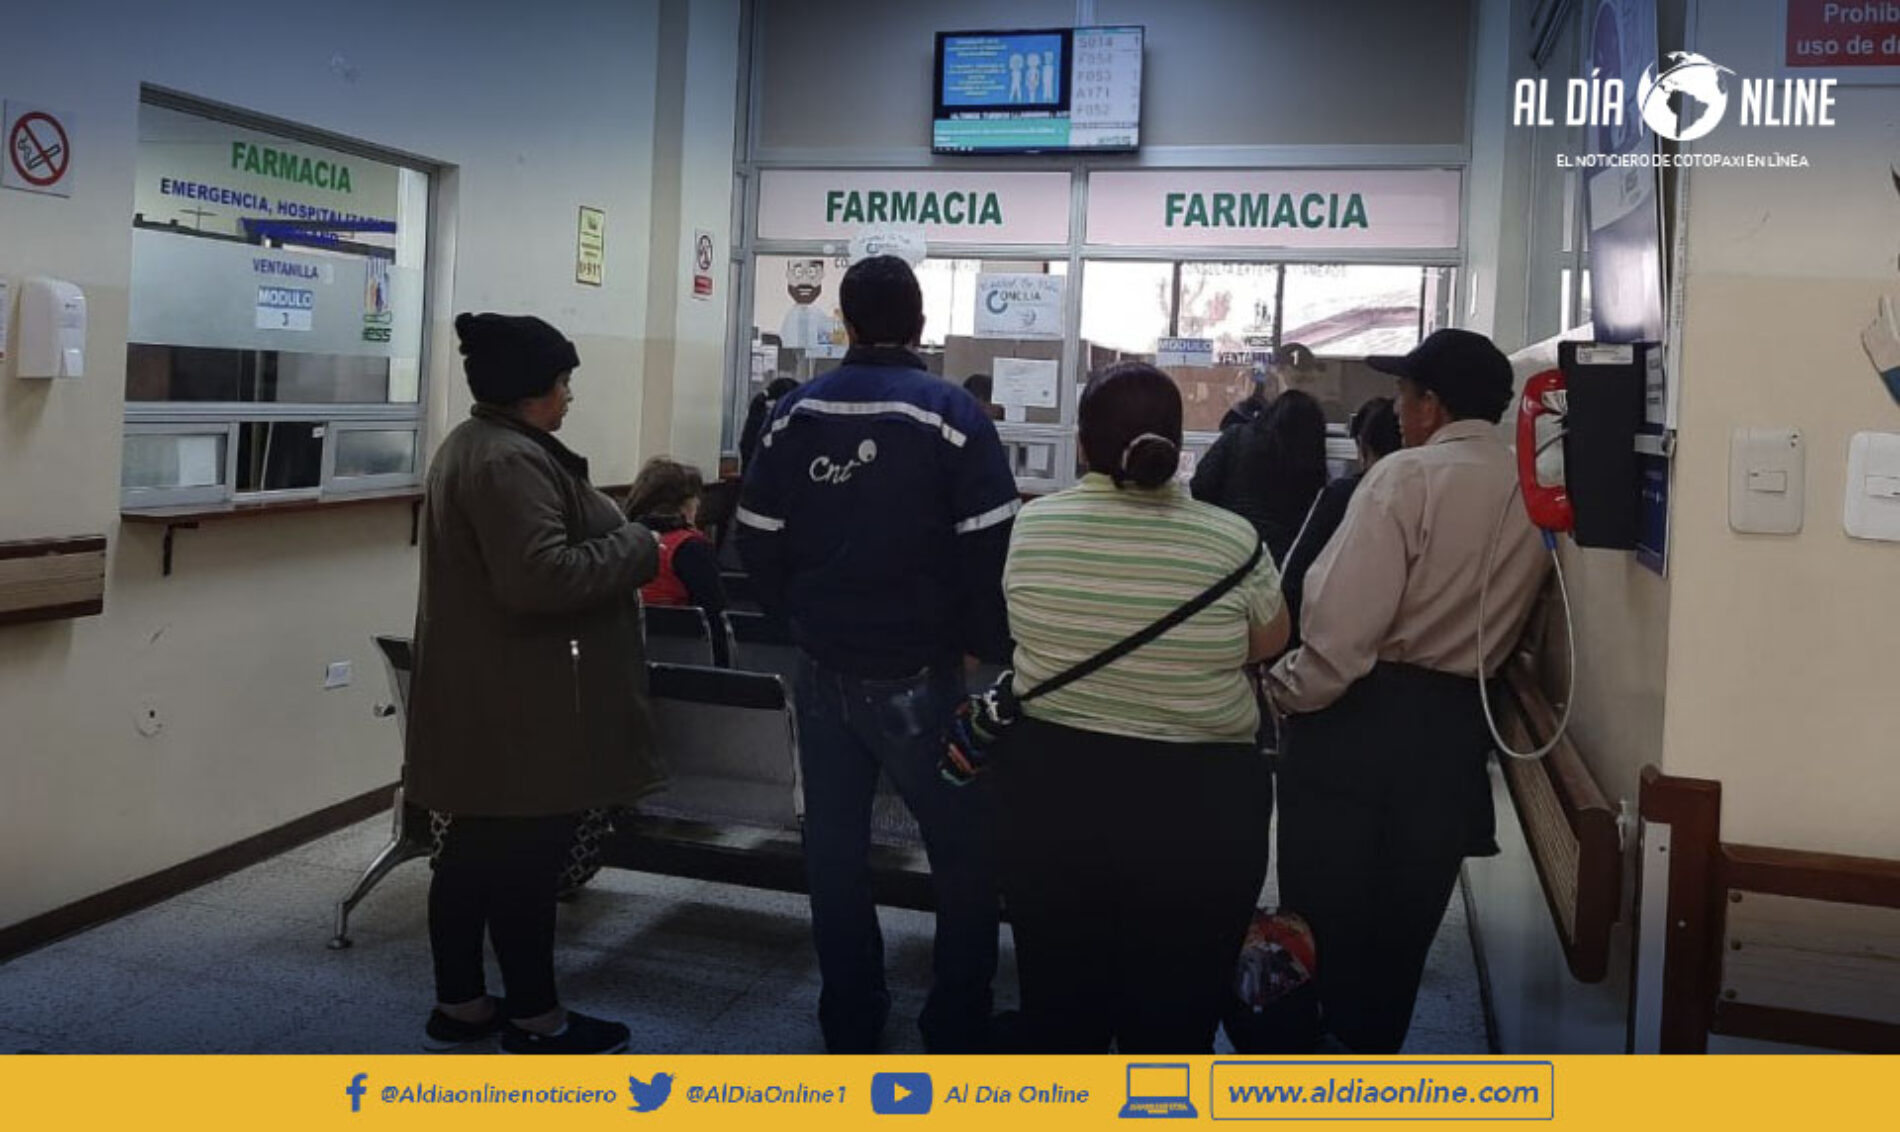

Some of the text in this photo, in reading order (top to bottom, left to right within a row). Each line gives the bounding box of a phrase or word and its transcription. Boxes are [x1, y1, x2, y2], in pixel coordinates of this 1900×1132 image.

[1797, 37, 1839, 55] uso
[1846, 32, 1873, 55] de
[231, 141, 352, 194] FARMACIA
[160, 177, 272, 215] EMERGENCIA,
[826, 190, 1003, 226] FARMACIA
[1165, 192, 1369, 229] FARMACIA
[252, 258, 319, 278] VENTANILLA
[258, 287, 313, 308] MODULO
